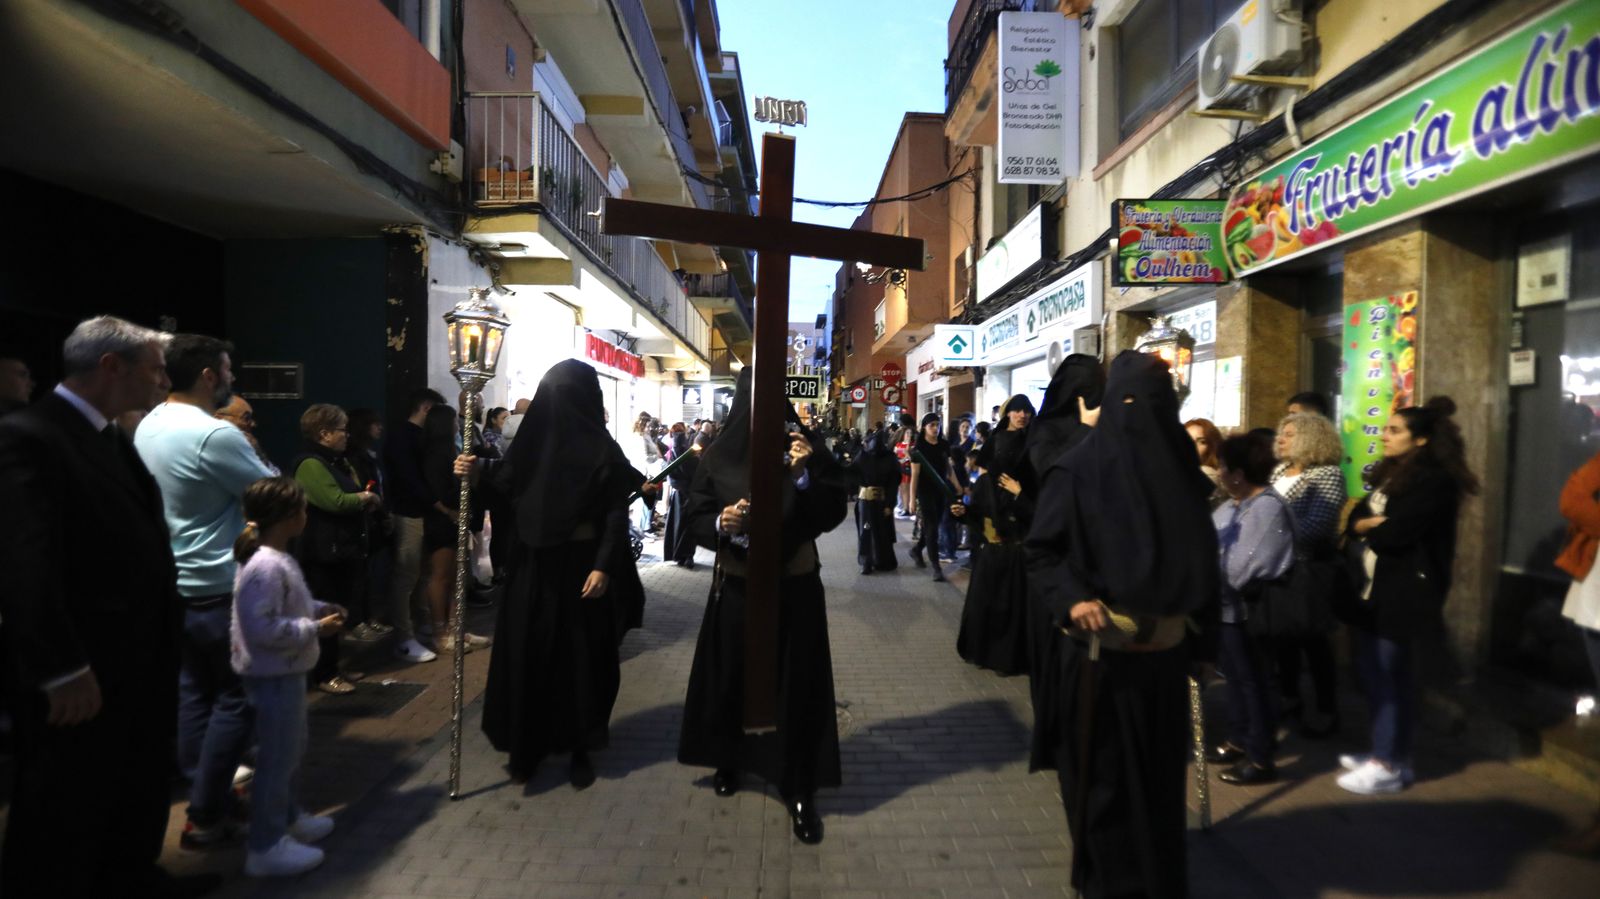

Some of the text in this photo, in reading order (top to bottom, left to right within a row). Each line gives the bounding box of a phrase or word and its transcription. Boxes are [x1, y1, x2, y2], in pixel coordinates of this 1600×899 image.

[1010, 45, 1053, 53] Bienestar
[1003, 112, 1044, 120] Bronceado
[1007, 156, 1058, 165] 956 17 61 64
[1004, 166, 1061, 175] 628 87 98 34
[1135, 256, 1212, 278] Oulhem
